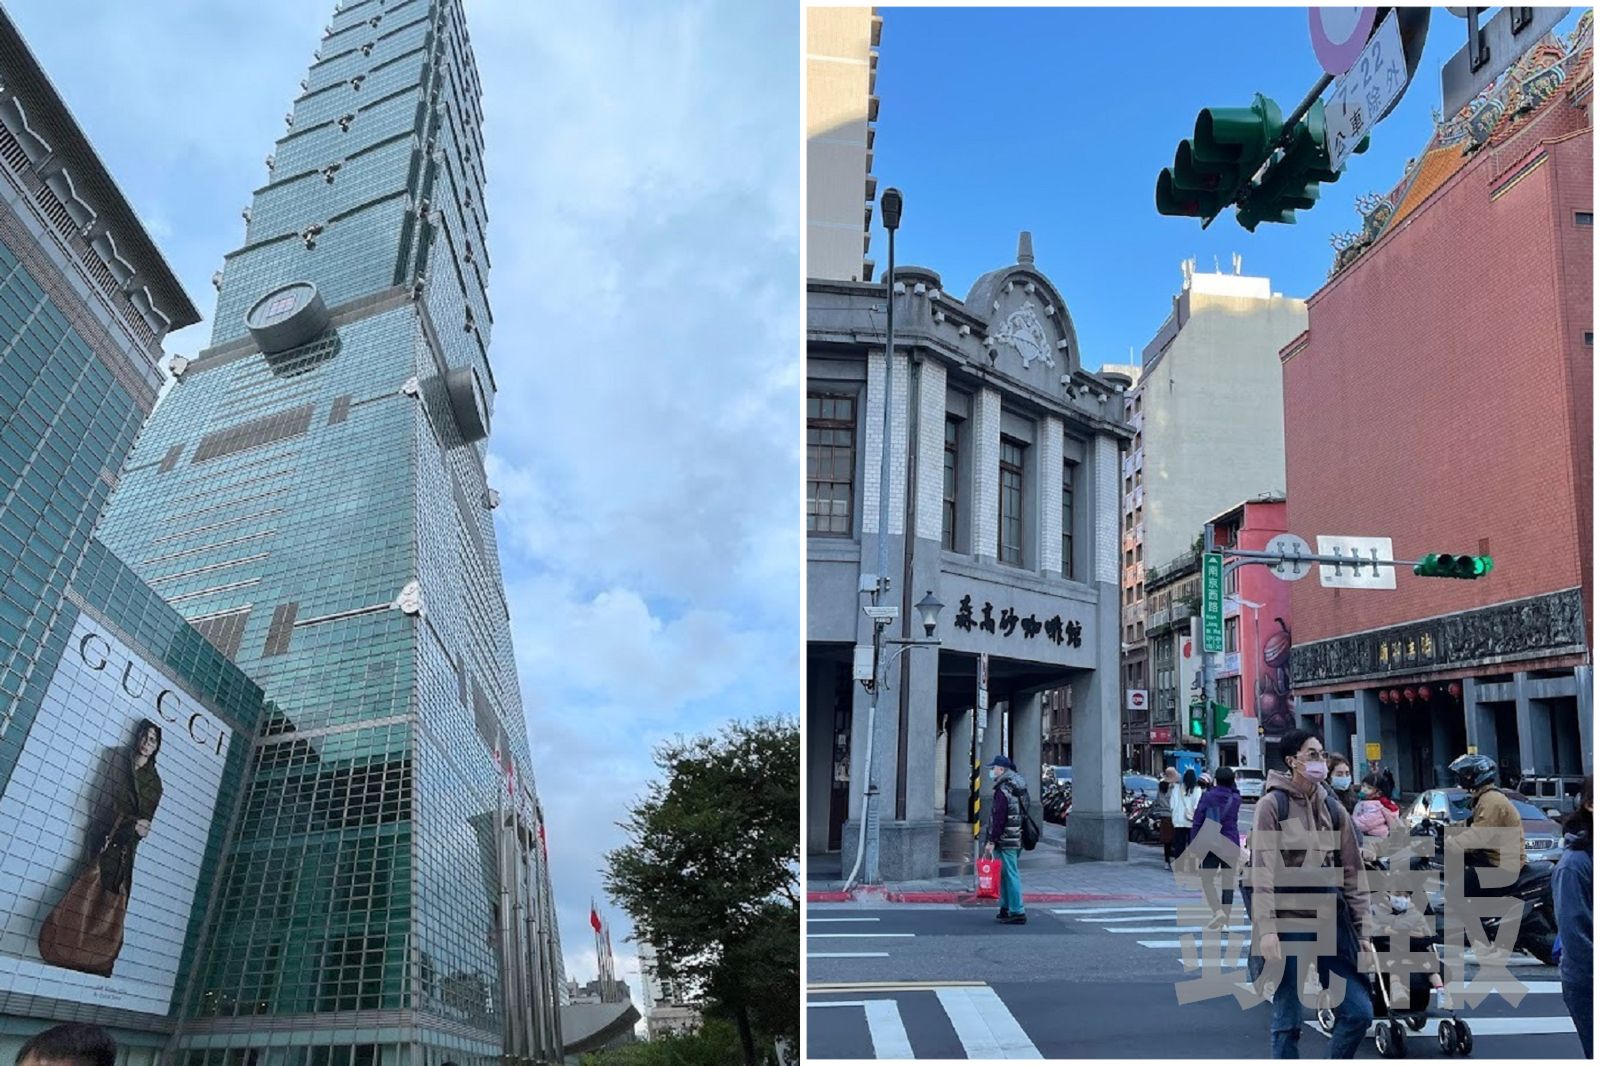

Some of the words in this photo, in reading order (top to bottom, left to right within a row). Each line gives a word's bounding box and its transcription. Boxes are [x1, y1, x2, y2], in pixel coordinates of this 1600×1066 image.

[1334, 60, 1400, 159] 公車除外
[1338, 41, 1384, 115] 7-22
[954, 594, 1082, 649] 森高砂咖啡館
[1208, 565, 1219, 613] 南京西路
[79, 632, 225, 756] GUCCI
